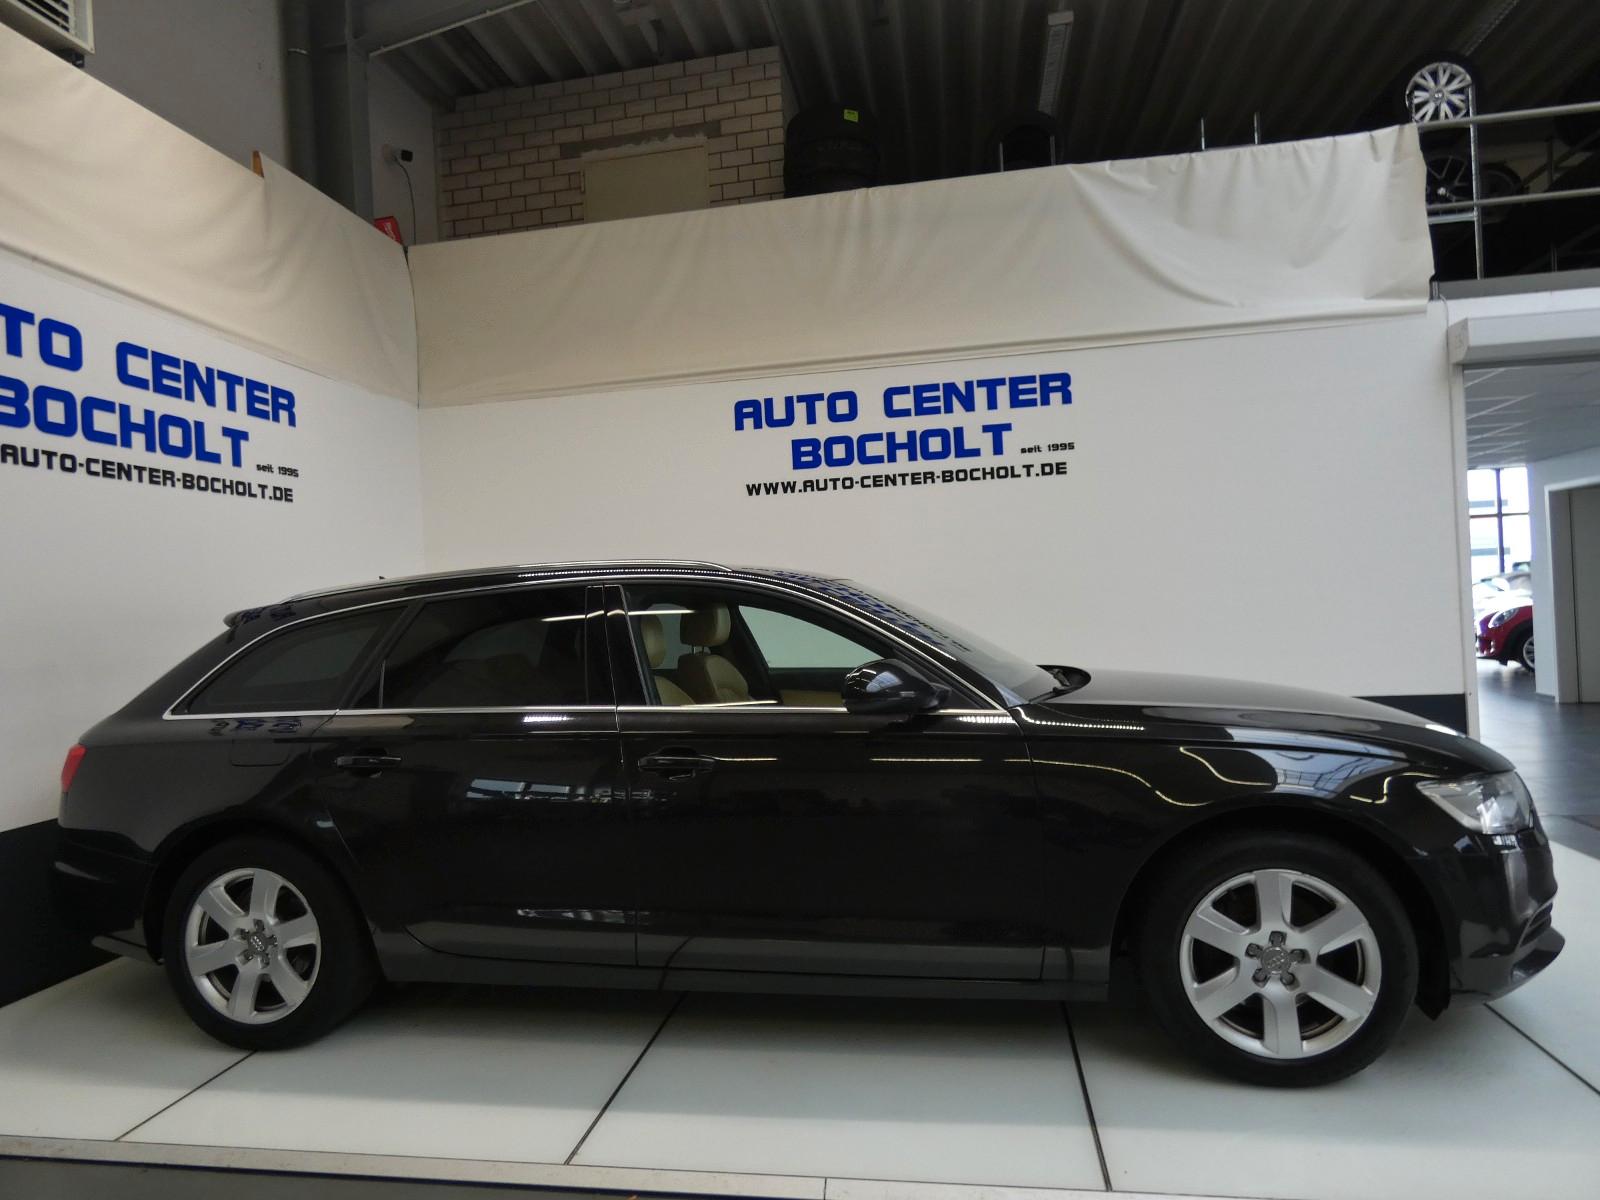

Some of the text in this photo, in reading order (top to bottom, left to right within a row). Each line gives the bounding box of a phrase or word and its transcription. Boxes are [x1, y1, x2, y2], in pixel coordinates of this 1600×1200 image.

[115, 341, 297, 427] CENTER
[734, 372, 1073, 431] AUTO CENTER
[791, 422, 1013, 471] BOCHOLT
[1020, 441, 1075, 454] seit 1995
[256, 463, 300, 478] seit 1995
[745, 461, 1068, 497] WWW.AUTO-CENTER-BOCHOLT.DE
